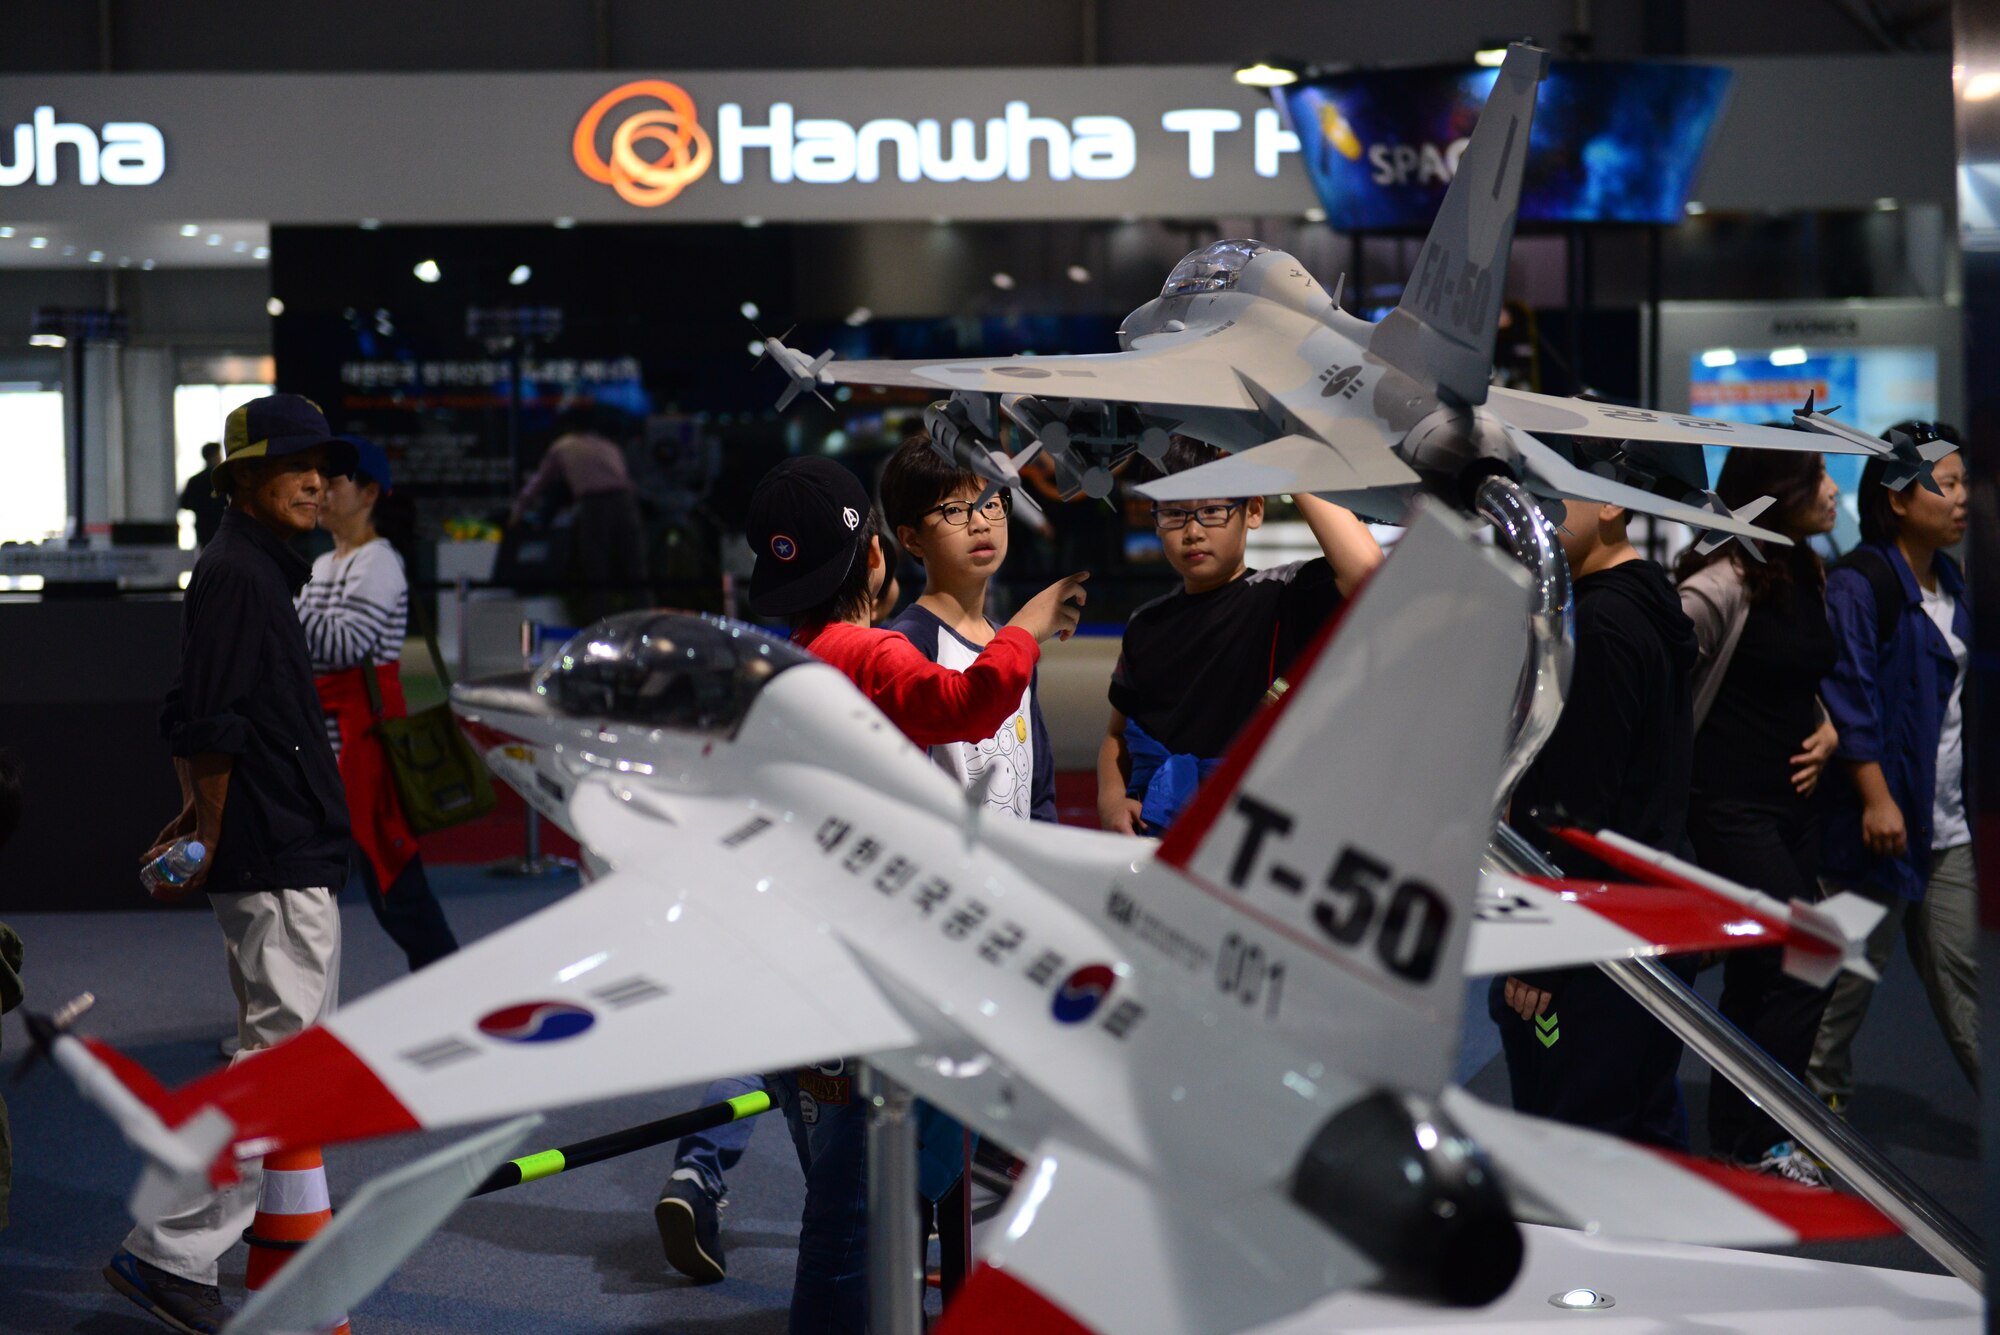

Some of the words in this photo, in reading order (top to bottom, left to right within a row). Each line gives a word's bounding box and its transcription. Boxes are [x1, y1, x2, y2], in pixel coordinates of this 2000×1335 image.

[718, 101, 1136, 184] Hanwha
[1414, 242, 1492, 336] FA-50
[1228, 794, 1454, 987] T-50
